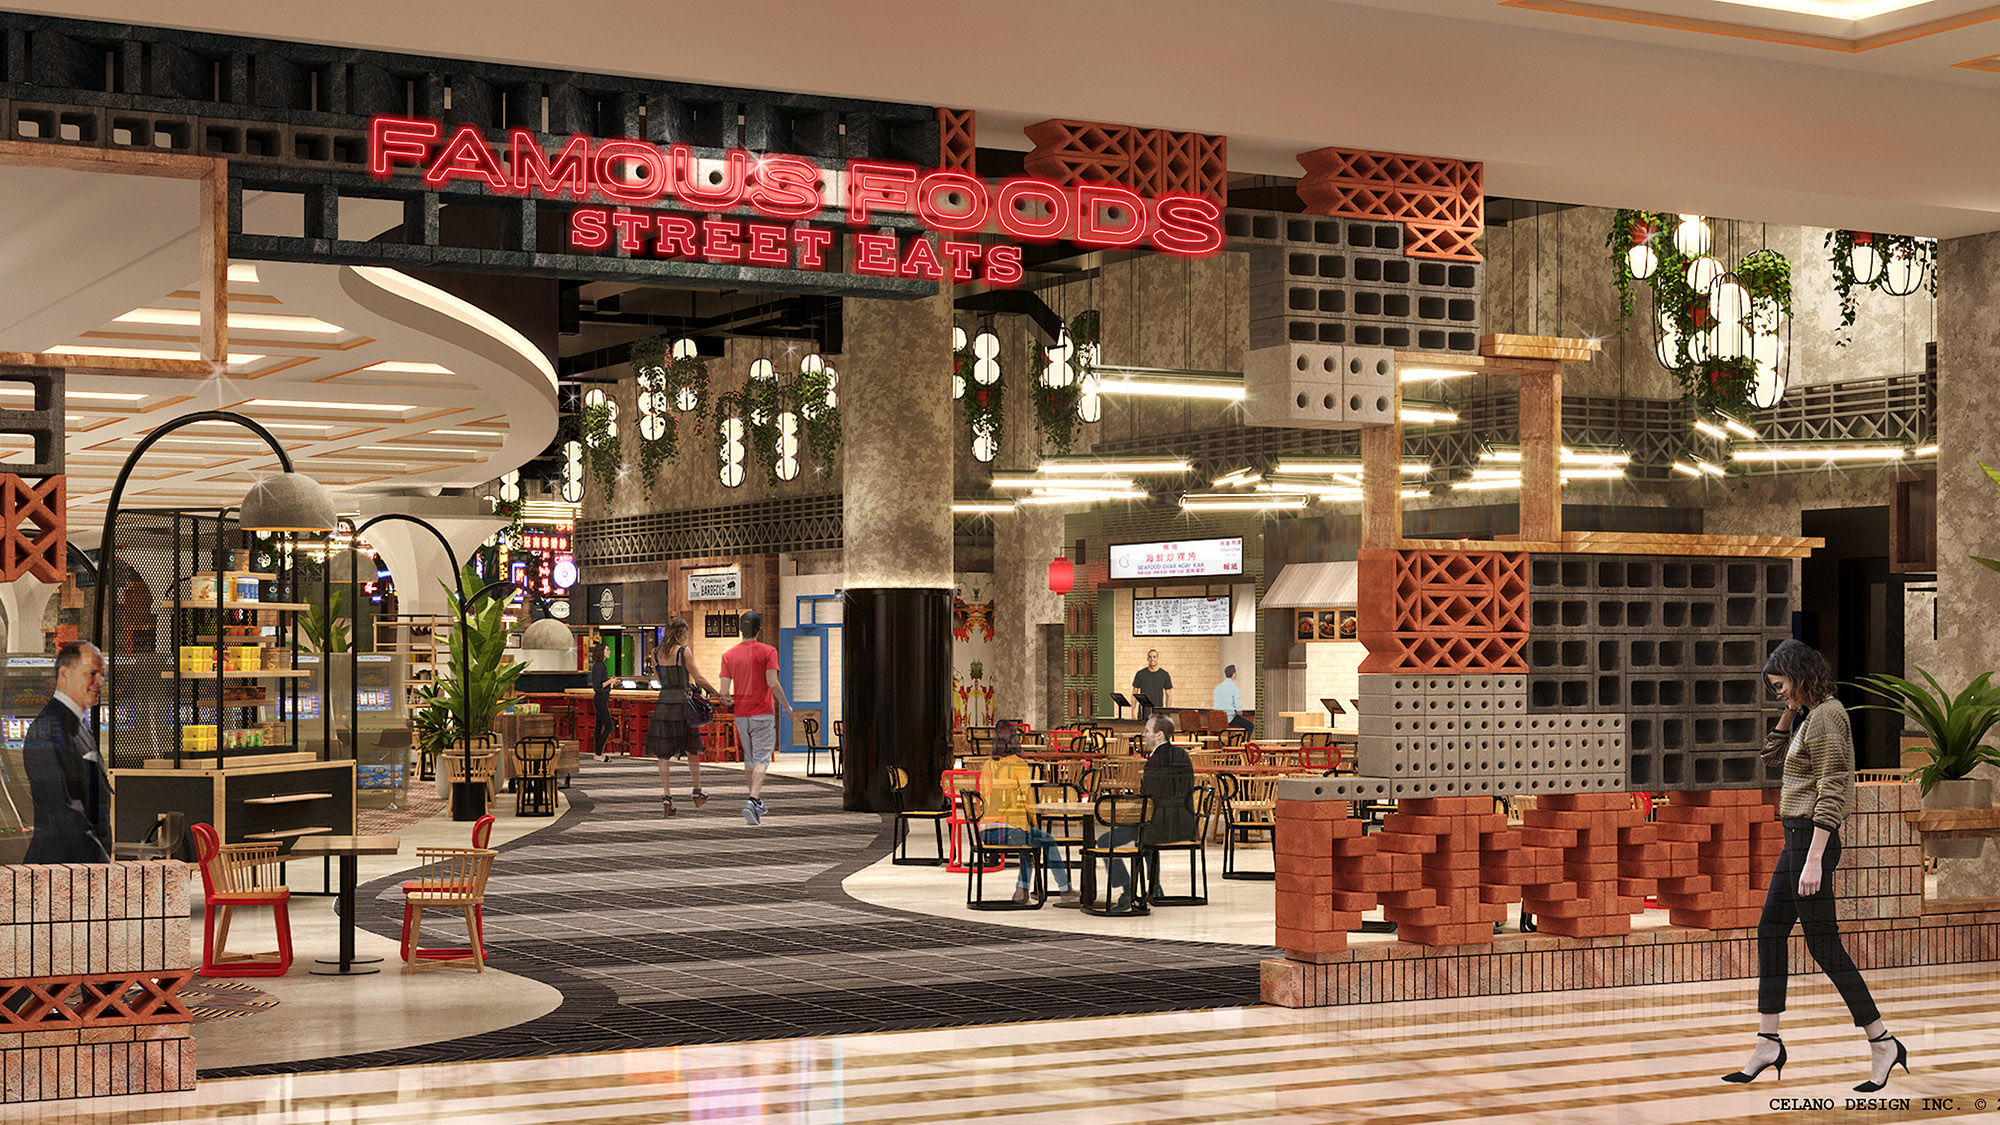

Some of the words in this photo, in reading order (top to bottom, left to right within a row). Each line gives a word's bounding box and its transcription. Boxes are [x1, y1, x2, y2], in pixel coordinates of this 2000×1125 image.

[372, 117, 821, 217] FAMOUS
[850, 163, 1222, 254] FOODS
[571, 210, 831, 266] STREET
[857, 234, 1023, 283] EATS
